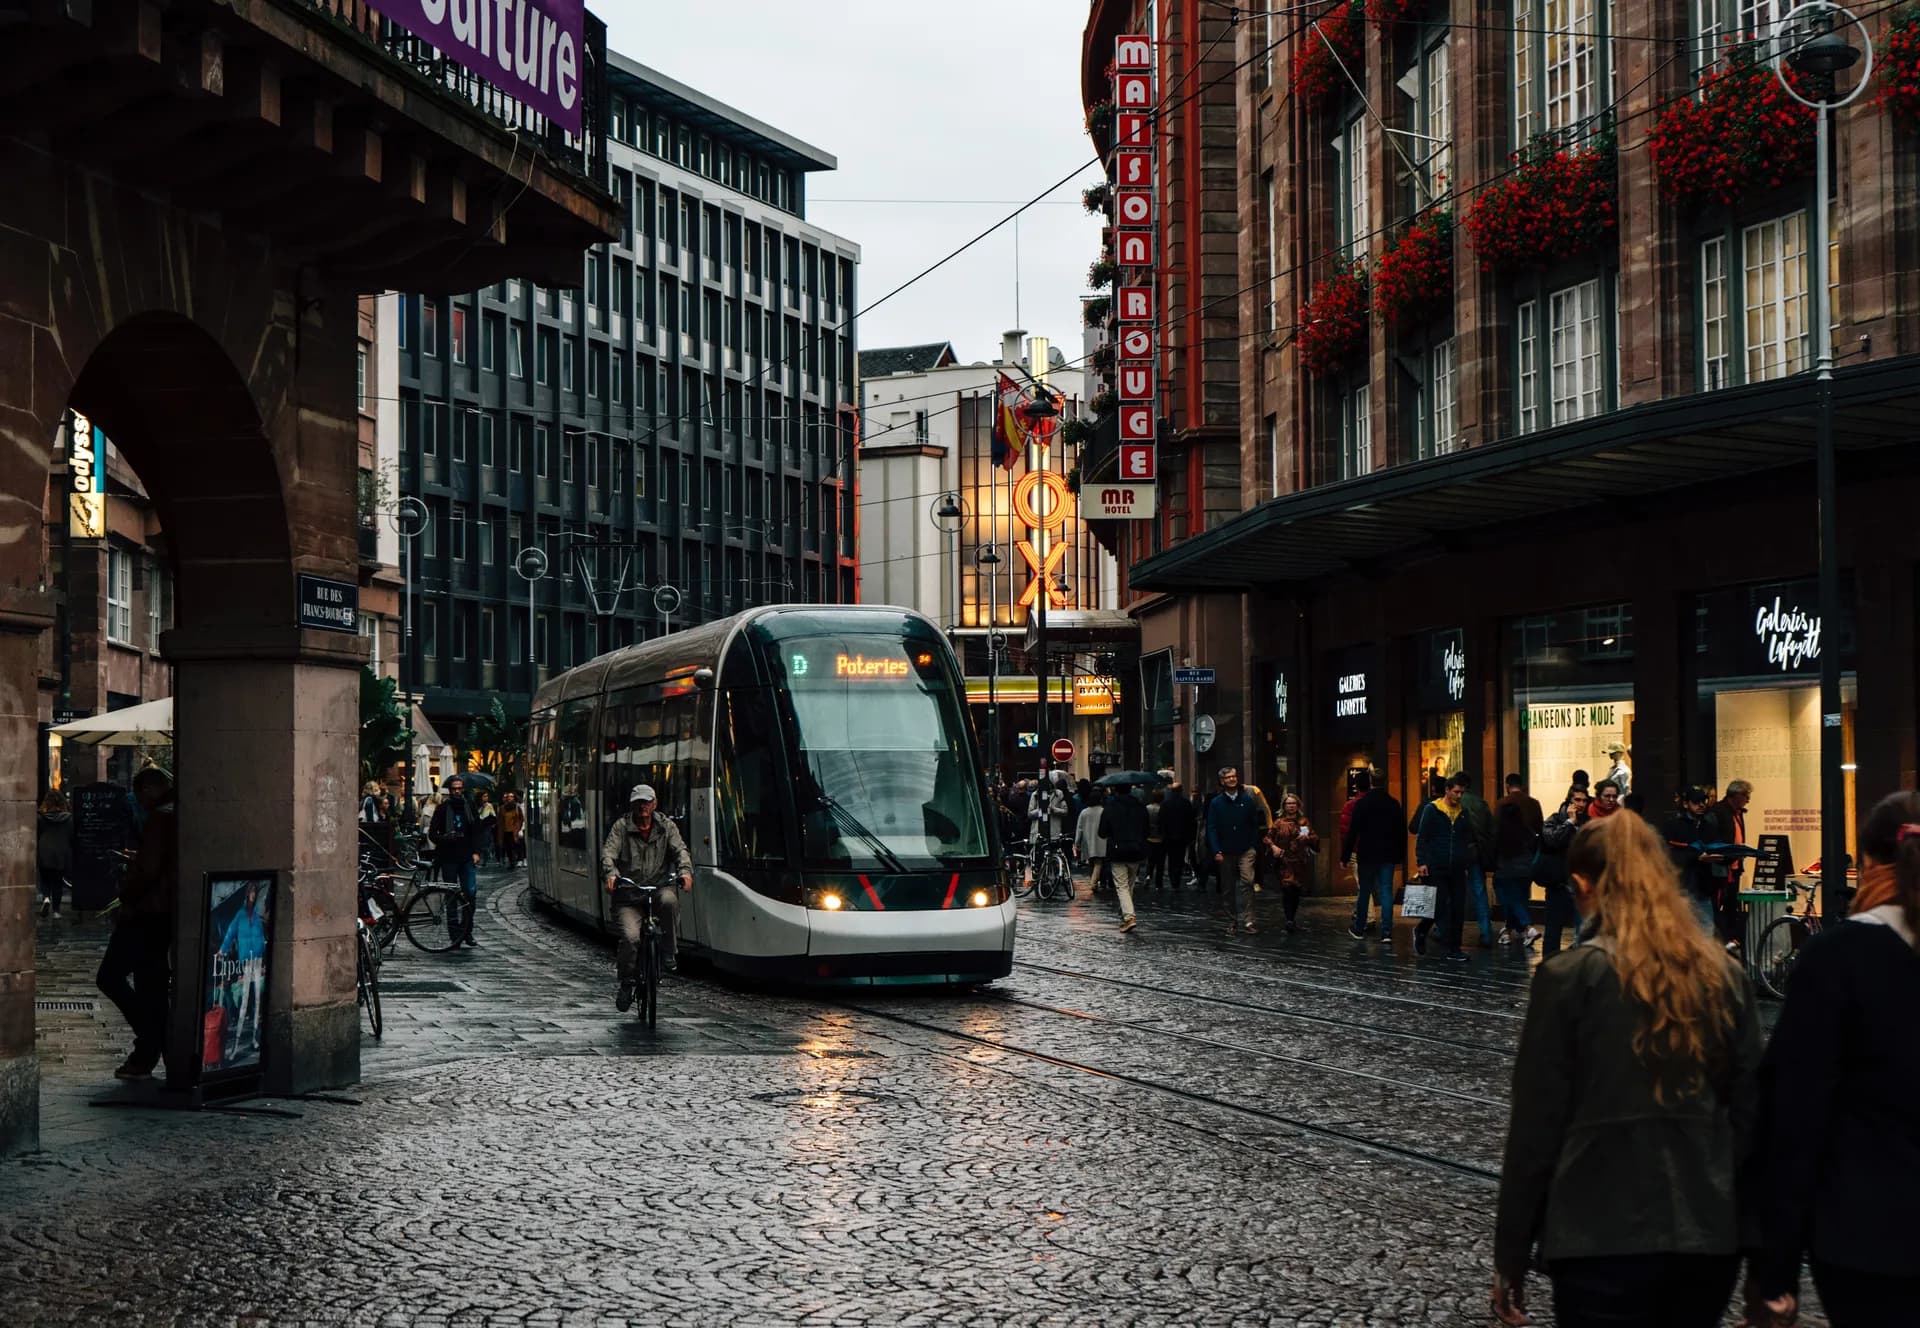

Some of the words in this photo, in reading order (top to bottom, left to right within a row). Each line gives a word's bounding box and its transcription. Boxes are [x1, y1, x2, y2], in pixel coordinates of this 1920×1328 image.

[1119, 40, 1150, 261] MAISON
[1124, 292, 1150, 475] ROUGE
[1101, 489, 1135, 504] MR
[1104, 506, 1131, 514] HOTEL
[316, 586, 329, 600] RUE
[330, 589, 343, 602] DES
[792, 655, 808, 674] D
[837, 654, 908, 675] Poteries
[1339, 673, 1366, 694] GALERIES
[1336, 696, 1367, 717] LAFAYETTE
[1521, 708, 1572, 731] CHANGEONS
[1575, 707, 1586, 727] DE
[1590, 705, 1615, 726] MODE
